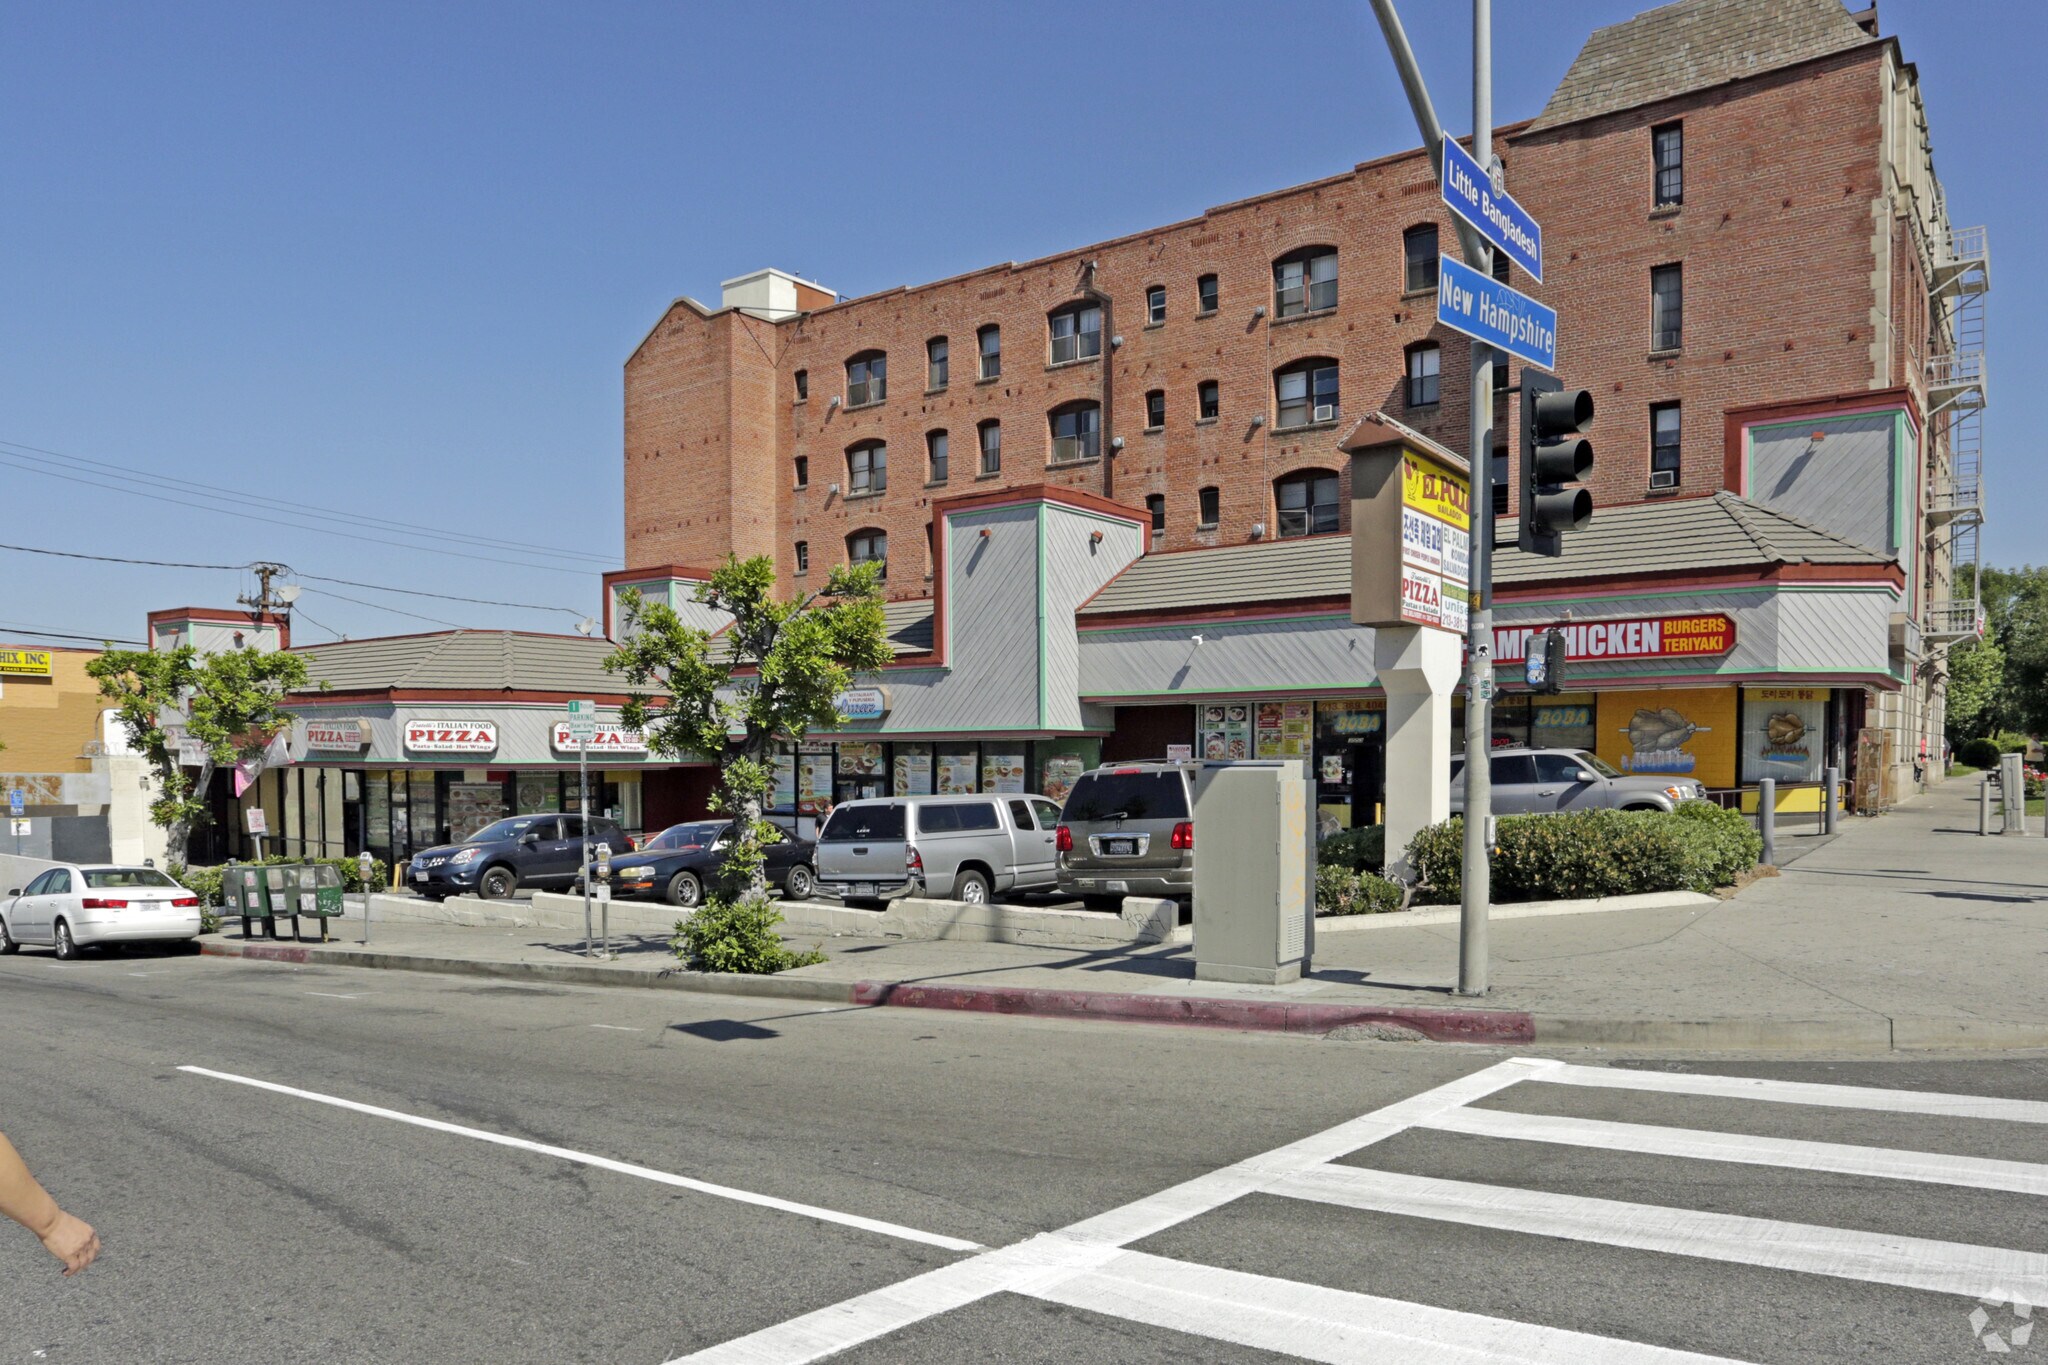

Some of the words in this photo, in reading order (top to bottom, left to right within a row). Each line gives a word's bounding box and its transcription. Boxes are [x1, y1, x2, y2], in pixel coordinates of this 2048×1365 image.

[1449, 160, 1478, 207] Little
[1482, 190, 1537, 261] Bangladesh
[1442, 273, 1473, 316] New
[1480, 291, 1553, 354] Hampshire
[1423, 474, 1438, 500] EL
[1440, 476, 1470, 515] POLL
[1438, 504, 1462, 521] BAILADOR
[1404, 513, 1419, 545] 조선족
[1444, 526, 1451, 545] EL
[1452, 530, 1469, 552] PALM
[1443, 559, 1469, 579] SALVADOR
[1402, 577, 1439, 607] PIZZA
[1664, 618, 1726, 635] BURGERS
[1541, 622, 1660, 657] HICKEN
[1664, 636, 1723, 652] TERIYAKI
[25, 653, 48, 665] INC.
[470, 722, 492, 730] FOOD
[1334, 714, 1380, 732] BOBA
[1537, 708, 1589, 726] BOBA
[308, 730, 344, 742] PIZZA
[409, 730, 494, 743] PIZZA
[557, 732, 622, 744] PZA
